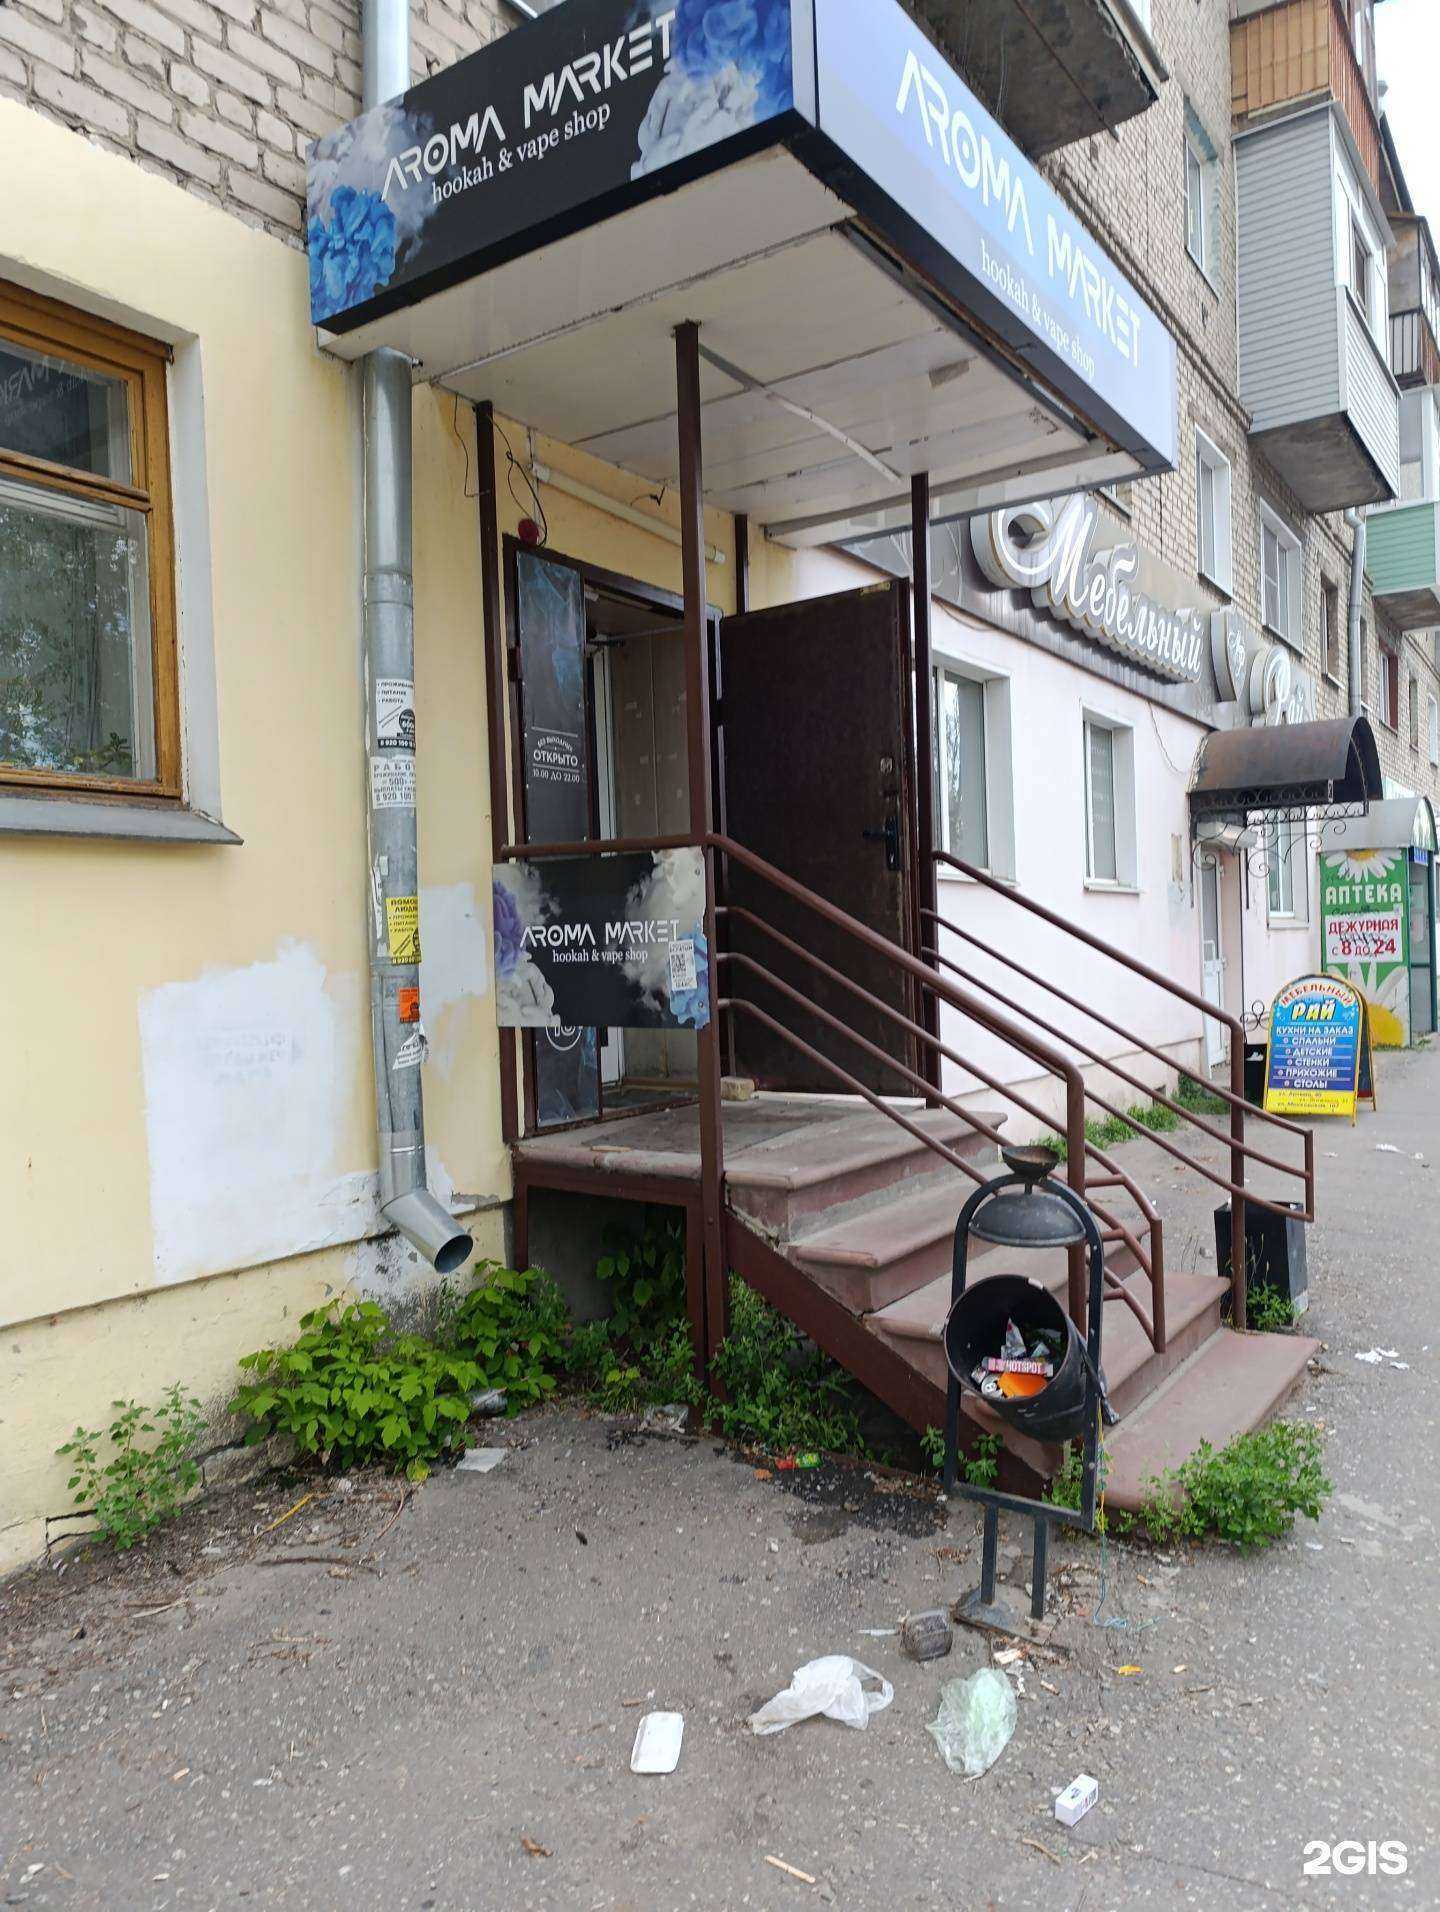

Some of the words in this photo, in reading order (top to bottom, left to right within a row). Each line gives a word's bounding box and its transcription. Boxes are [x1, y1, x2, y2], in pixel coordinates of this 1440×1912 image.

[381, 105, 506, 201] AROMA
[524, 9, 677, 129] MARKET
[432, 160, 494, 204] hookah
[498, 147, 513, 173] &
[517, 128, 560, 164] vape
[564, 102, 611, 141] shop
[896, 49, 1034, 257] AROMA
[1047, 213, 1141, 368] MARKET
[981, 239, 1030, 311] hookah
[1031, 298, 1042, 322] &
[1043, 311, 1071, 355] vape
[1071, 331, 1096, 379] shop
[997, 496, 1203, 674] Мебельный
[533, 749, 579, 768] ОТКРЫТО
[1325, 883, 1402, 905] АПТЕКА
[520, 923, 596, 948] AROMA
[605, 920, 681, 946] MARKET
[1328, 918, 1398, 936] ДЕЖУРНАЯ
[1341, 940, 1352, 956] 8
[1374, 937, 1396, 956] 24
[552, 949, 589, 963] hookah
[591, 950, 600, 962] &
[601, 951, 624, 965] vape
[625, 948, 648, 963] shop
[1281, 983, 1354, 1006] МЕБЕЛЬНЫЙ
[1291, 999, 1336, 1021] РАЙ
[1276, 1026, 1306, 1035] КУХНИ
[1308, 1026, 1321, 1035] НА
[1324, 1025, 1354, 1035] ЗАКАЗ
[1291, 1037, 1336, 1046] СПАЛЬНИ
[1293, 1048, 1333, 1057] ДЕТСКИЕ
[1295, 1059, 1330, 1067] СТЕНКИ
[1286, 1069, 1338, 1078] ПРИХОЖИЕ
[1293, 1080, 1328, 1089] СТОЛЫ
